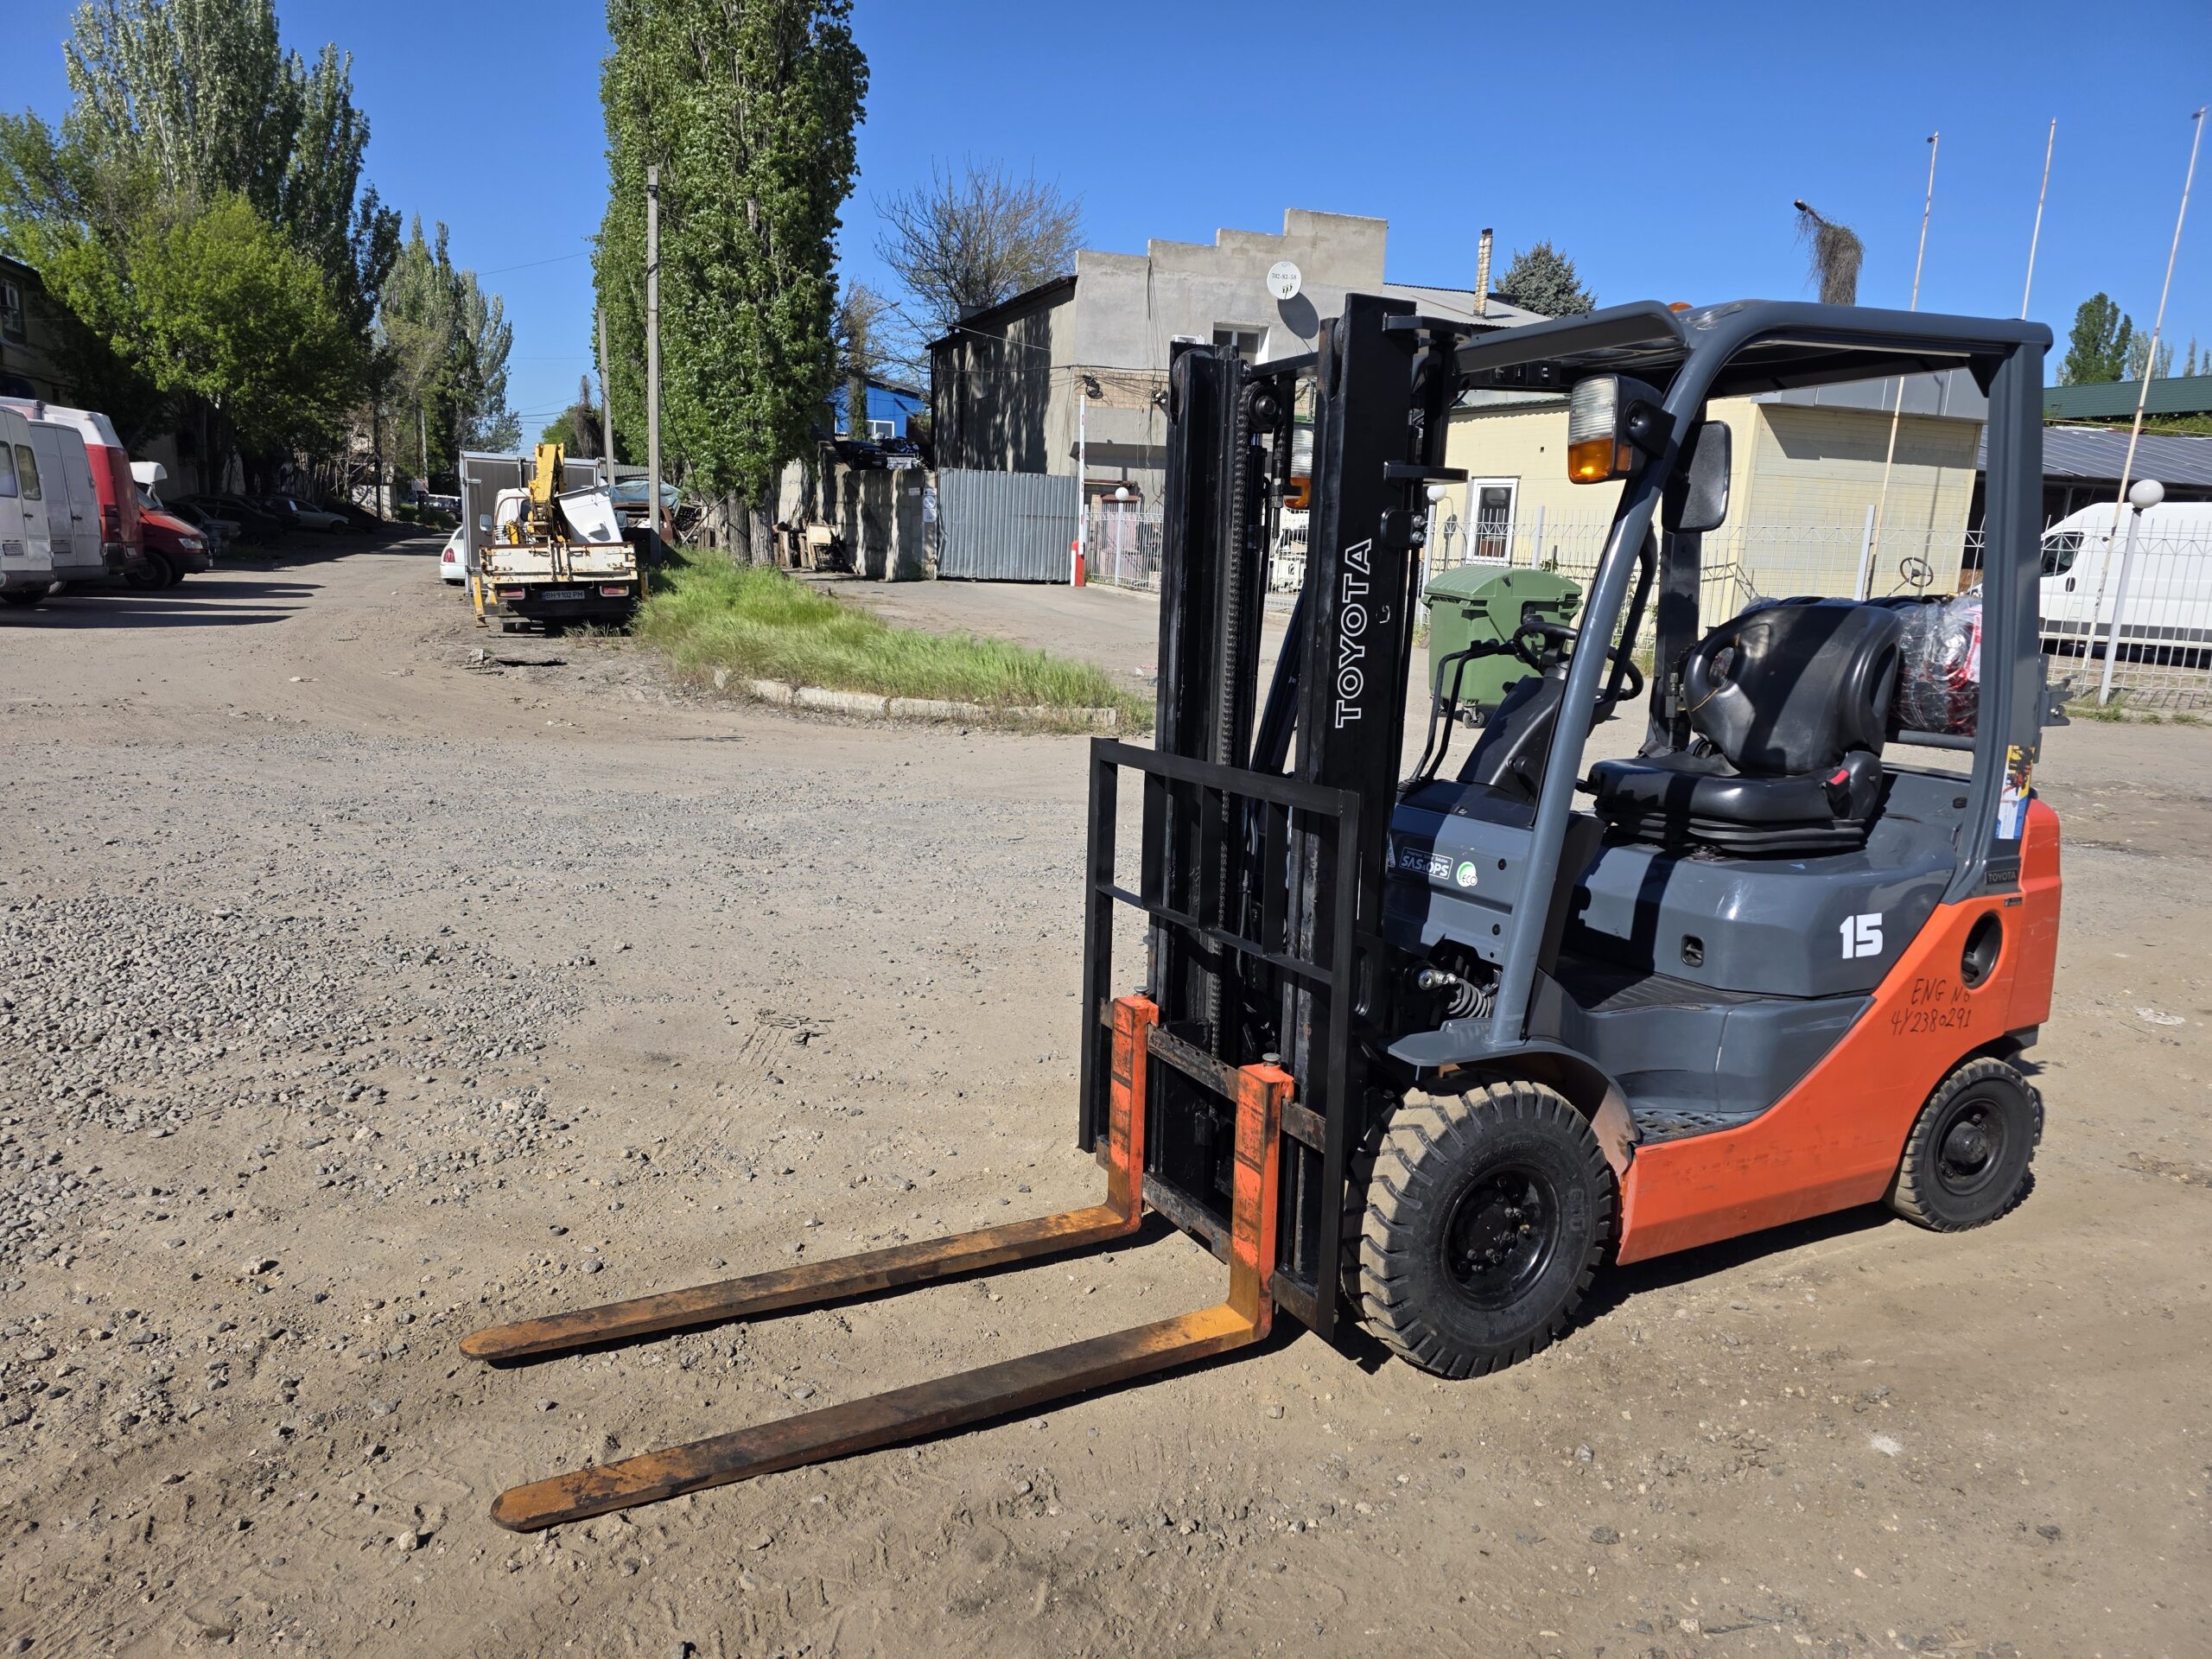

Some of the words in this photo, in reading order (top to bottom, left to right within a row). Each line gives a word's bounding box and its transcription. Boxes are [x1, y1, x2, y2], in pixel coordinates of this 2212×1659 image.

[1335, 537, 1372, 729] TOYOTA
[1462, 874, 1476, 885] ECO
[1988, 871, 2017, 882] TOYOTA
[1840, 912, 1883, 959] 15
[1911, 977, 1947, 1006] ENG
[1891, 1007, 1972, 1036] 4Y2380291
